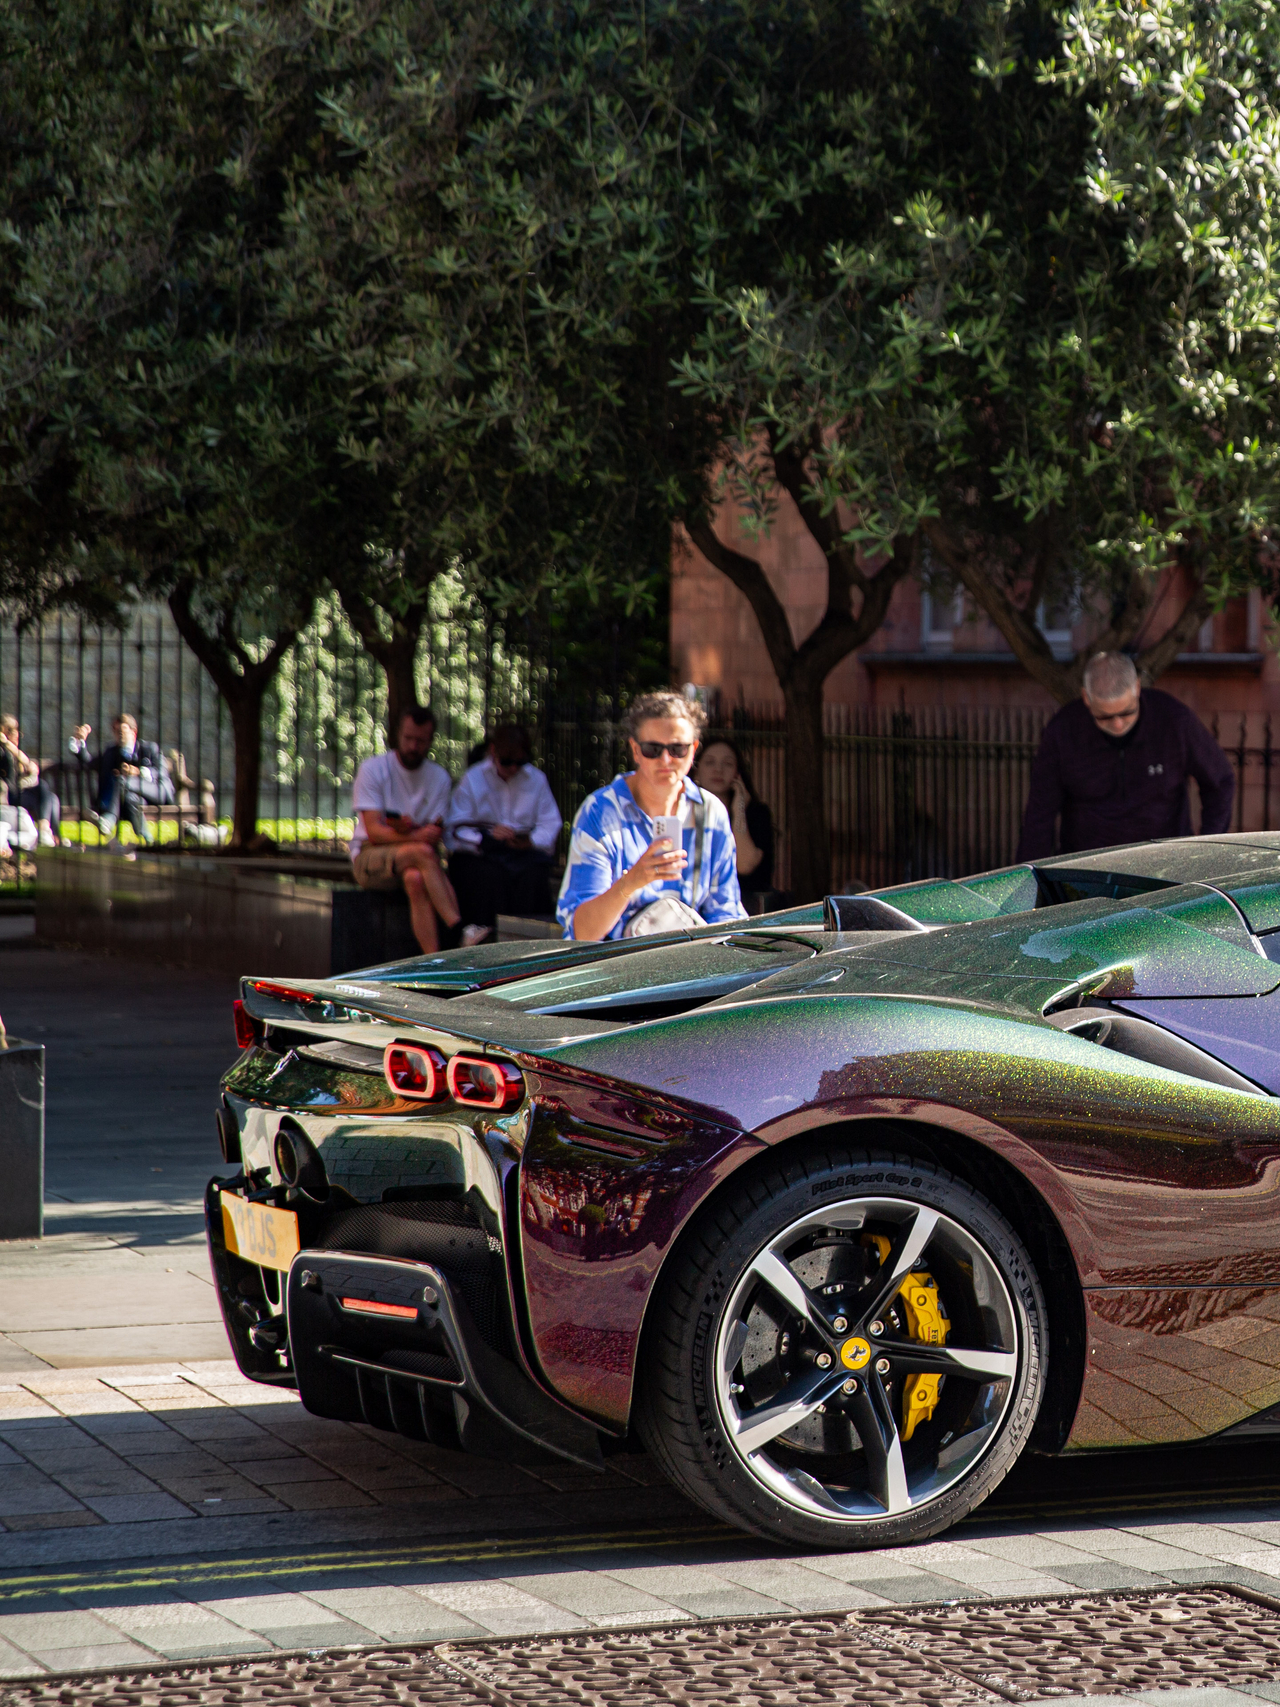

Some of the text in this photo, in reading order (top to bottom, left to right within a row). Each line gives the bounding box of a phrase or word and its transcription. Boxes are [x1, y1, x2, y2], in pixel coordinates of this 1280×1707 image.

[845, 1172, 884, 1186] Sport
[885, 1172, 909, 1186] Cup
[910, 1177, 923, 1188] 2
[692, 1312, 710, 1407] MICHELIN
[1026, 1308, 1041, 1400] MICHELIN
